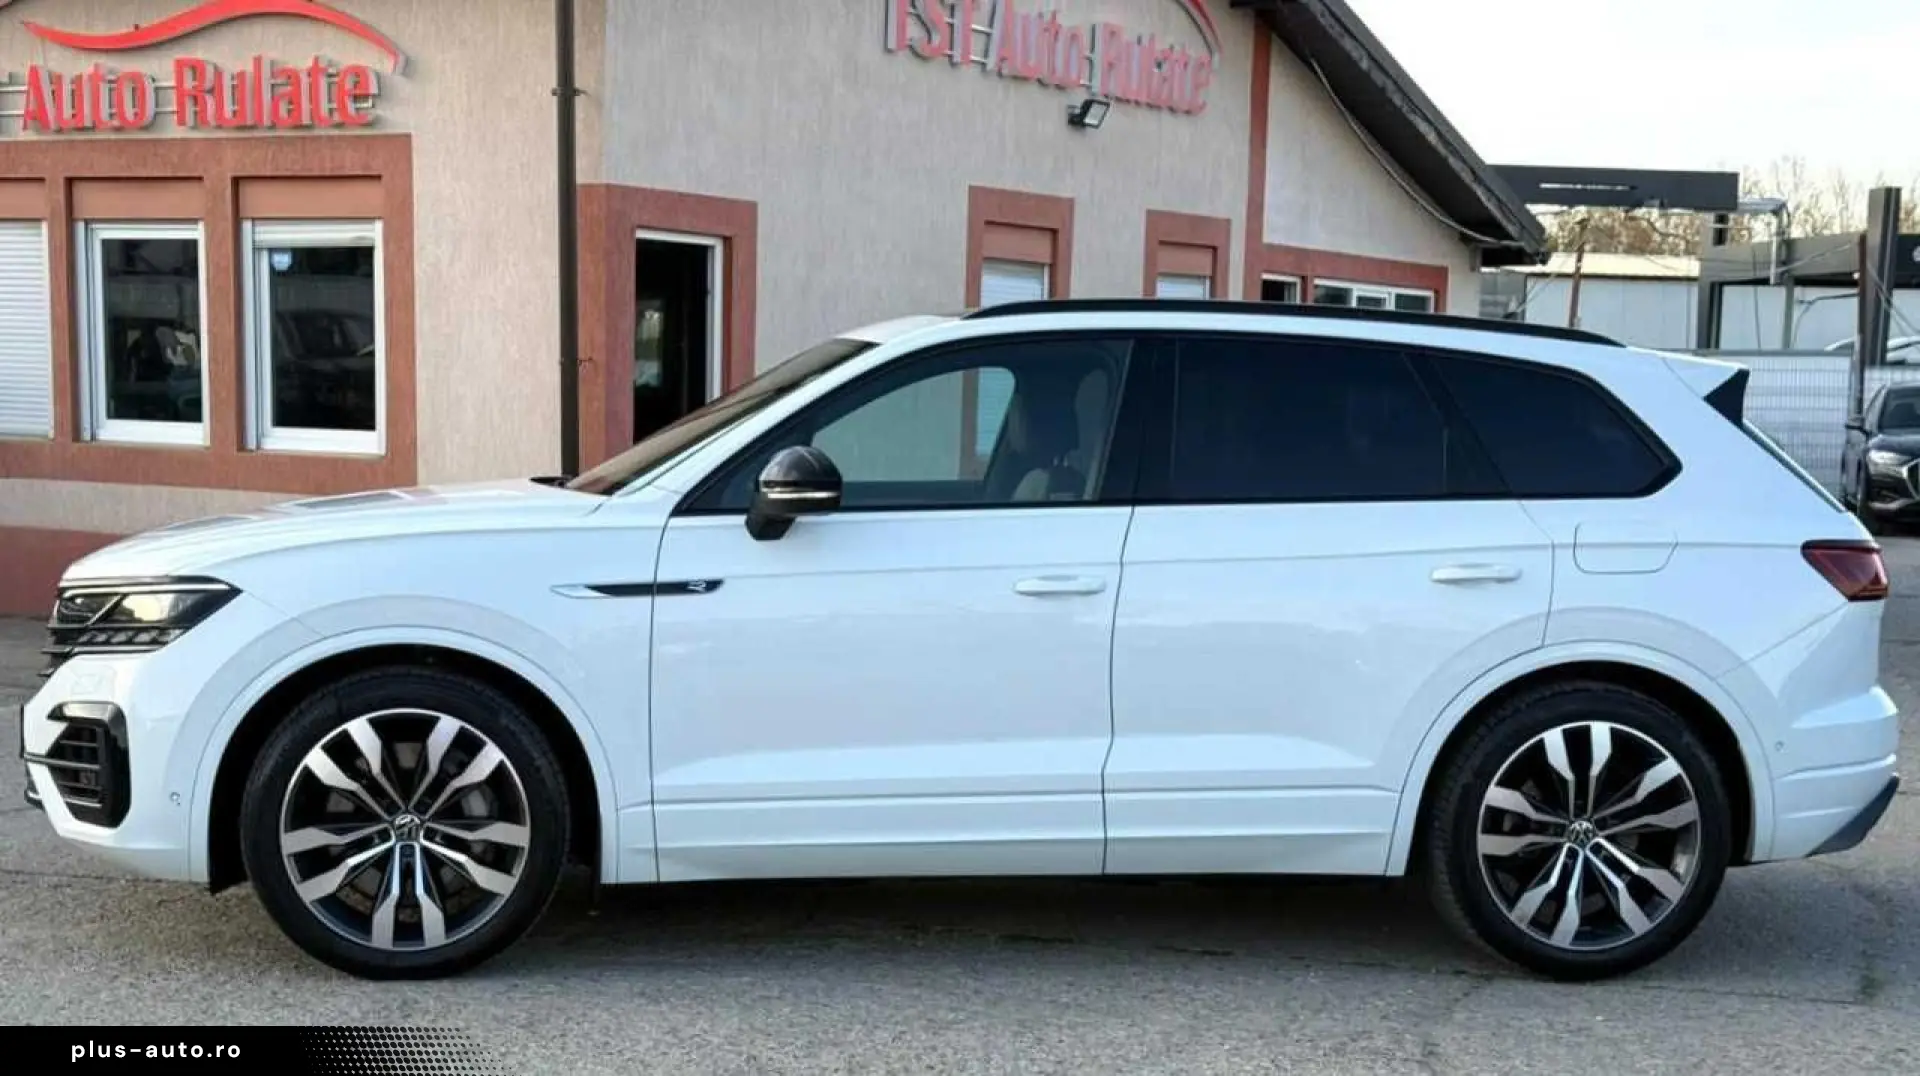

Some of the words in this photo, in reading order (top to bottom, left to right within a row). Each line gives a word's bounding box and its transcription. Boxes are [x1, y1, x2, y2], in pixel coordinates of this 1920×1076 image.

[23, 63, 154, 132] Auto
[174, 55, 379, 128] Rulate
[985, 0, 1086, 89] Auto
[1091, 22, 1214, 115] Rulate
